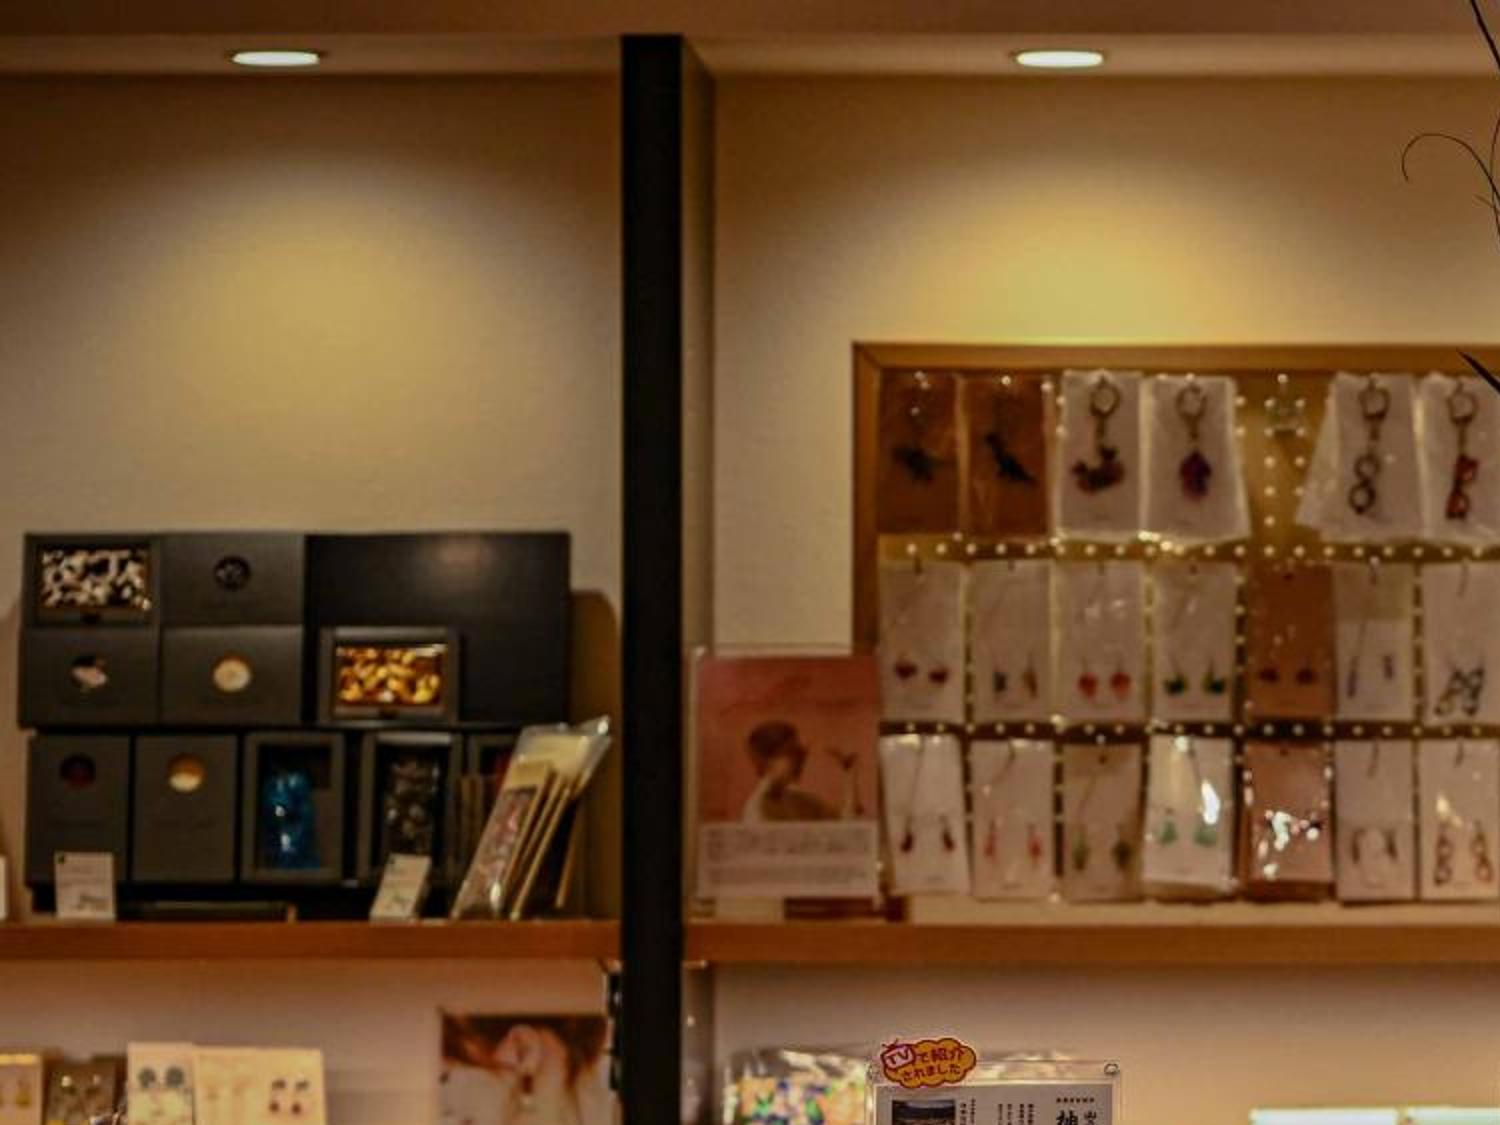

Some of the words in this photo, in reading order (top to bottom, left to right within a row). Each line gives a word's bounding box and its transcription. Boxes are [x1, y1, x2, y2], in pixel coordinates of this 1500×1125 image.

[903, 1064, 961, 1081] されました
